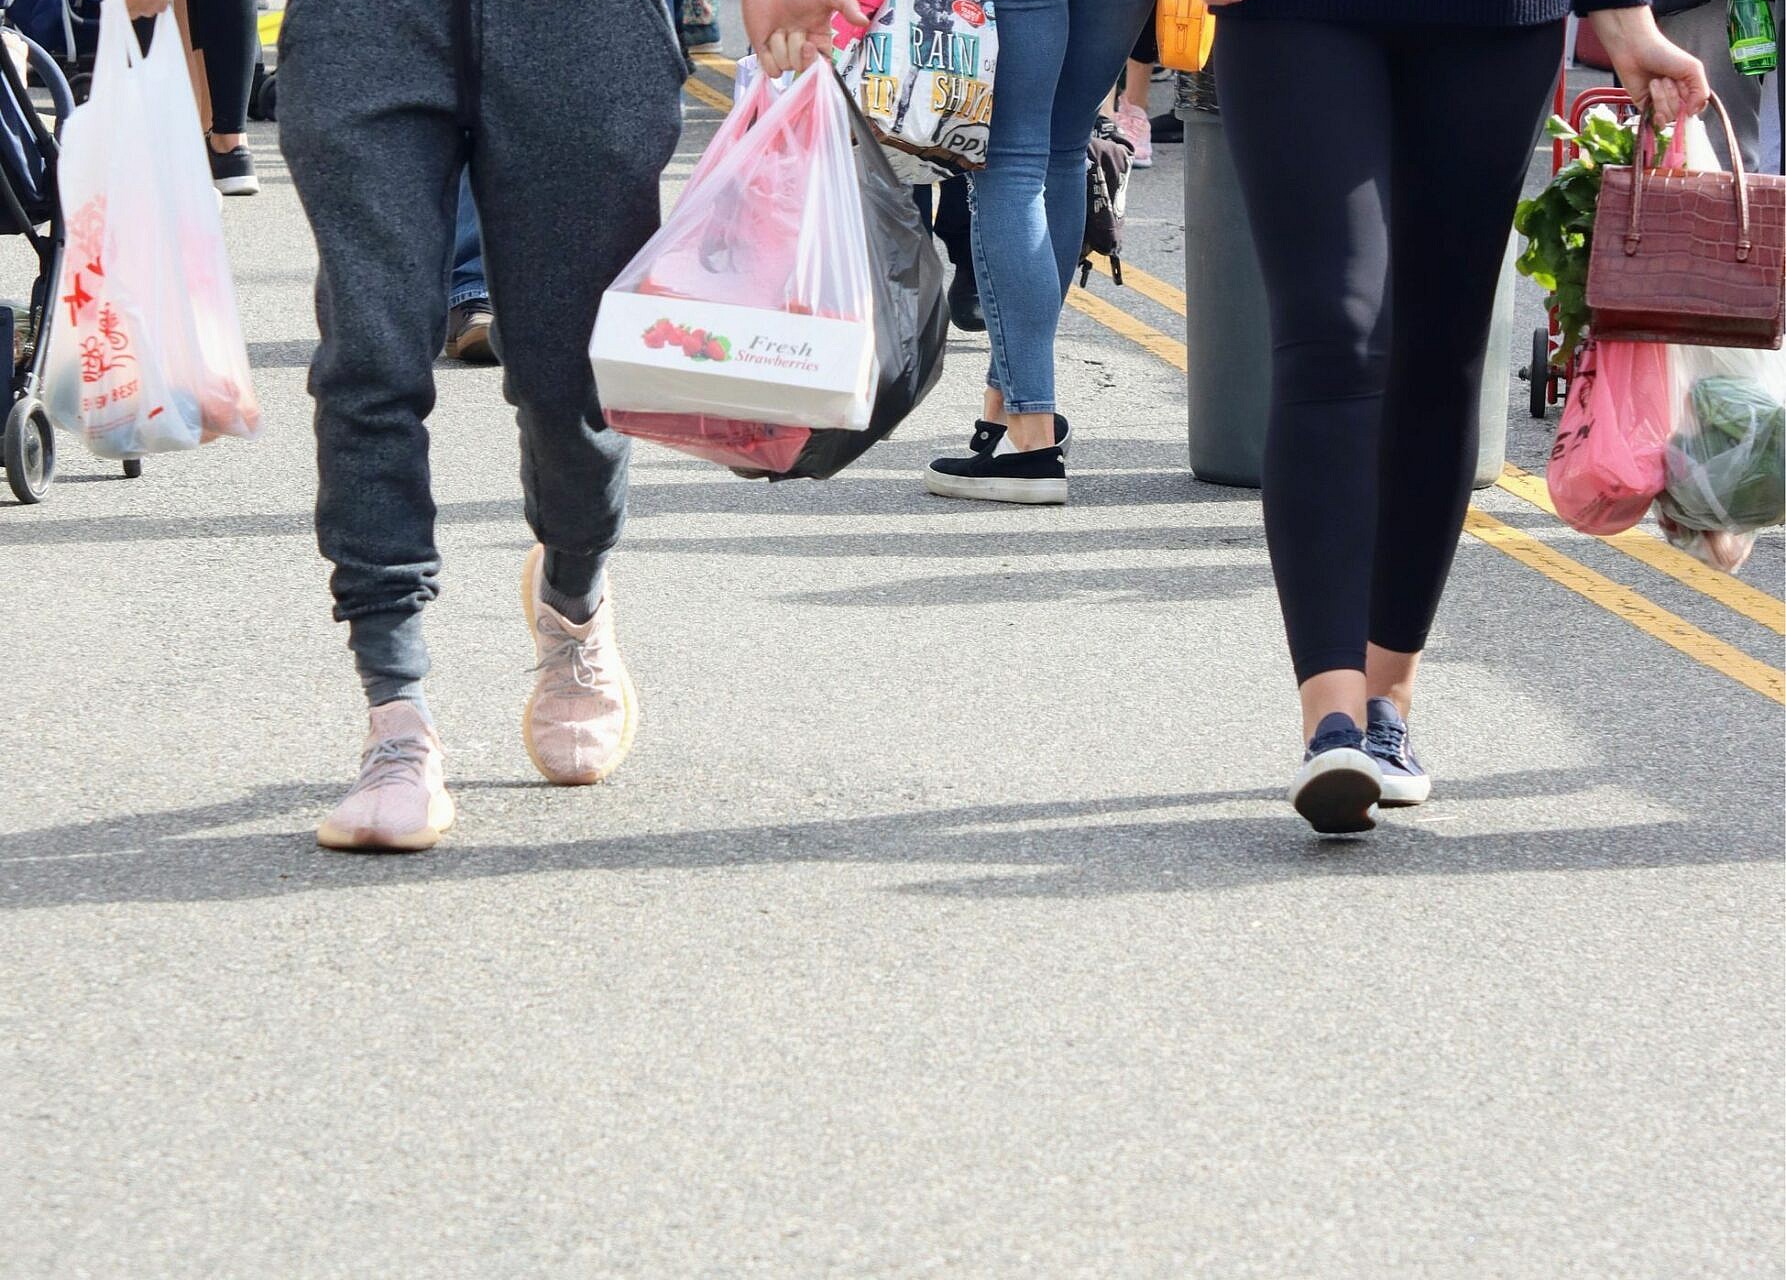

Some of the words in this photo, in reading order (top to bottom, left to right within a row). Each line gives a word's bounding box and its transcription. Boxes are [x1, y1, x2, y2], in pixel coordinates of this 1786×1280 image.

[911, 26, 976, 77] RAIN
[749, 335, 813, 357] Fresh
[736, 349, 819, 371] Strawberries
